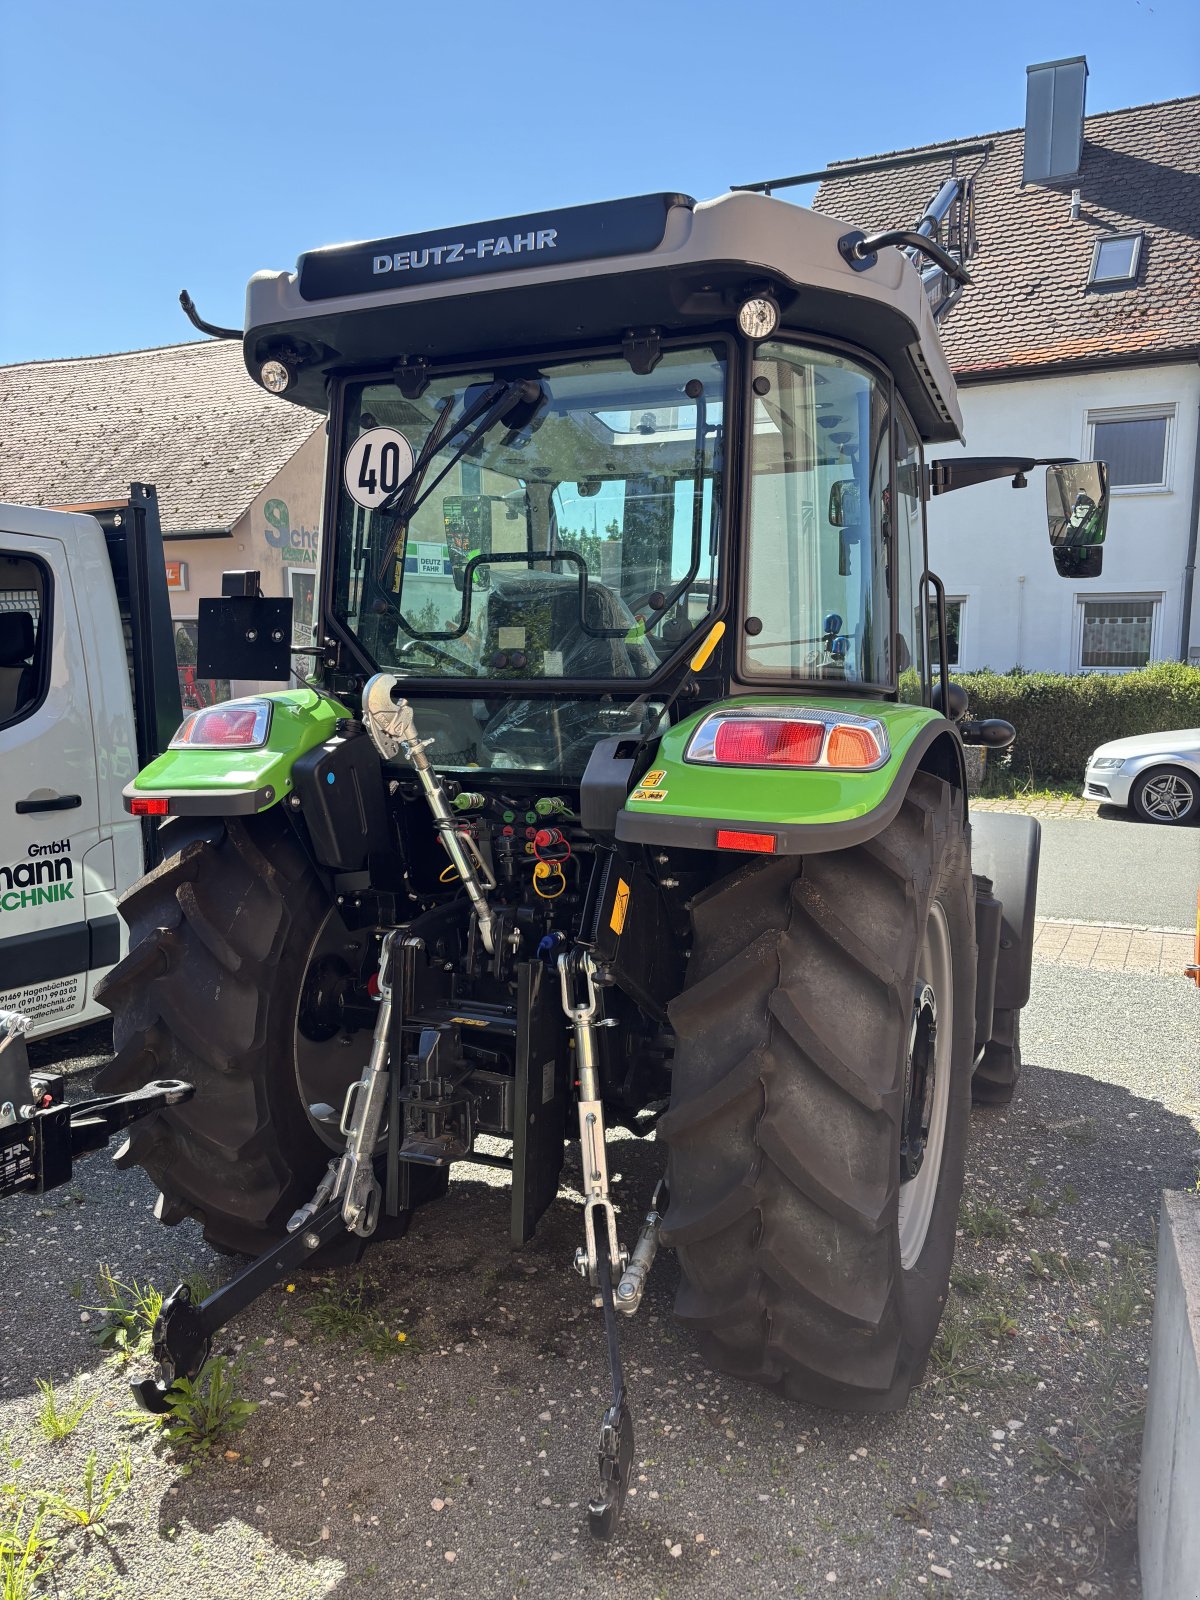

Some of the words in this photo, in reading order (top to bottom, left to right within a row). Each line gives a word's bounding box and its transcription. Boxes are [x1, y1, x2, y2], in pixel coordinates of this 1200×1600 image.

[373, 229, 557, 274] DEUTZ-FAHR
[358, 441, 400, 494] 40
[421, 558, 441, 566] DEUTZ
[422, 565, 440, 573] FAHR
[28, 839, 71, 857] GmbH
[0, 881, 75, 912] CHNIK
[28, 1003, 75, 1020] ndtechnik.de
